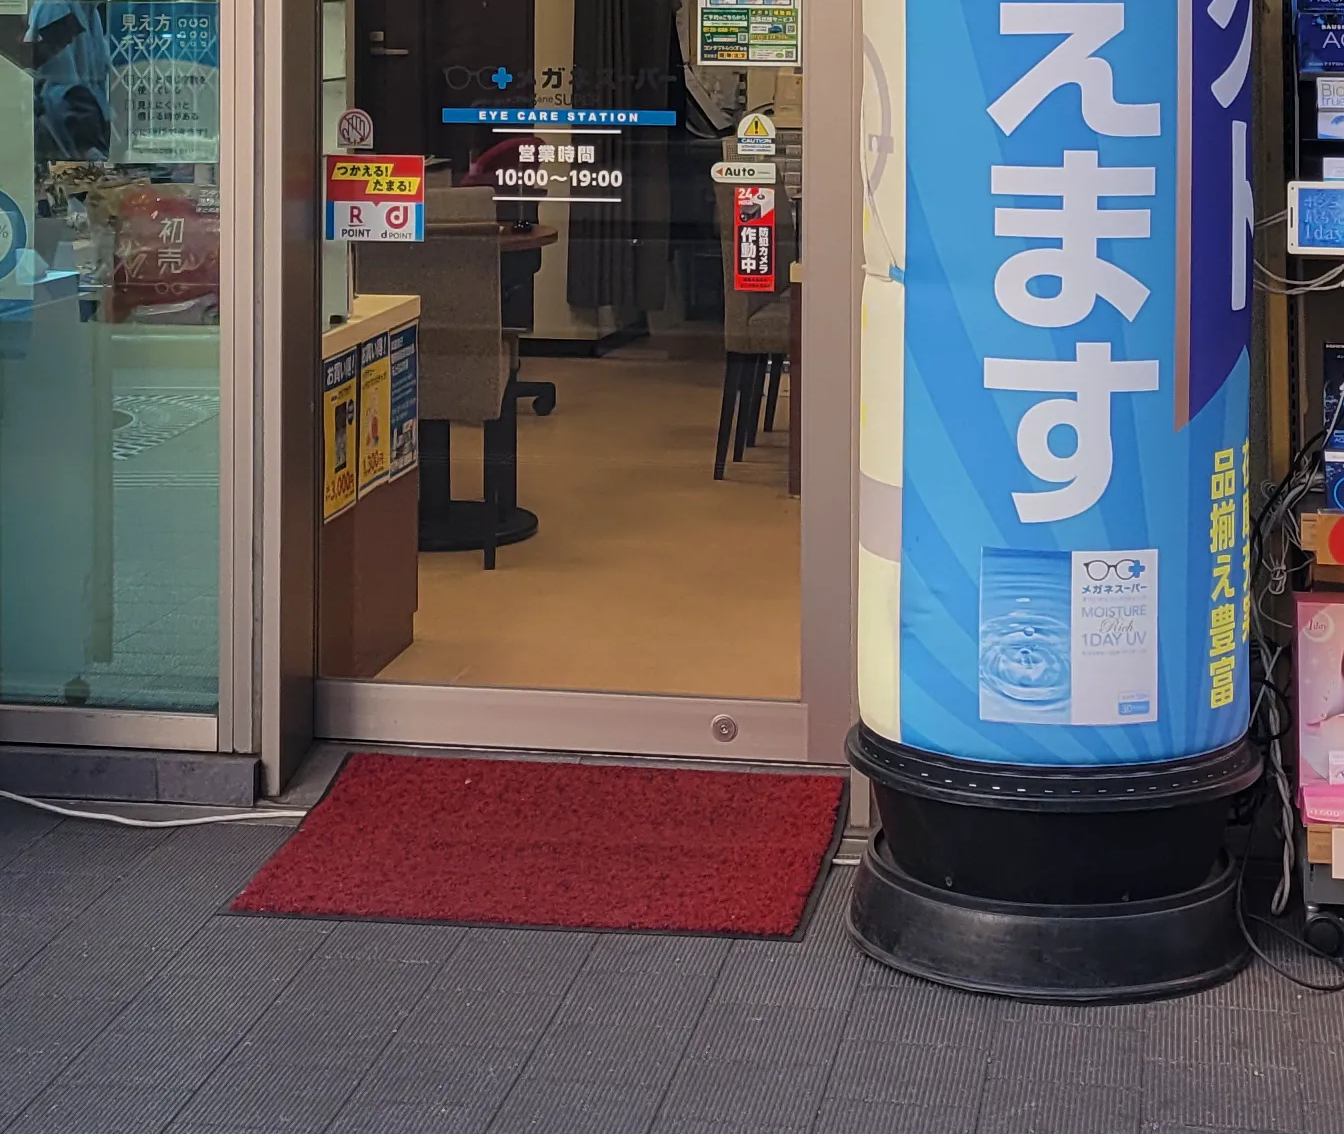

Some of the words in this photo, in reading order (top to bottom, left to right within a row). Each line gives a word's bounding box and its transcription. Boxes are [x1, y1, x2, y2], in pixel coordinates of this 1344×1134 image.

[478, 110, 509, 121] EYE
[516, 111, 560, 122] CARE
[567, 112, 639, 123] STATION
[518, 144, 595, 164] 営業時間
[336, 164, 389, 178] つかえる!
[495, 168, 623, 188] 10:00〜19:00
[724, 167, 756, 178] Auto
[371, 179, 412, 193] たまる!
[737, 187, 754, 200] 24
[341, 228, 372, 238] POINT
[740, 226, 757, 274] 作動中
[758, 226, 770, 275] 防犯カメラ
[1208, 447, 1237, 711] 品揃え豊富
[1081, 583, 1149, 596] メガネスーパー
[1081, 604, 1147, 618] MOISTURE
[1099, 617, 1135, 634] Rich
[1081, 633, 1122, 648] 1DAY
[1126, 630, 1147, 646] UV
